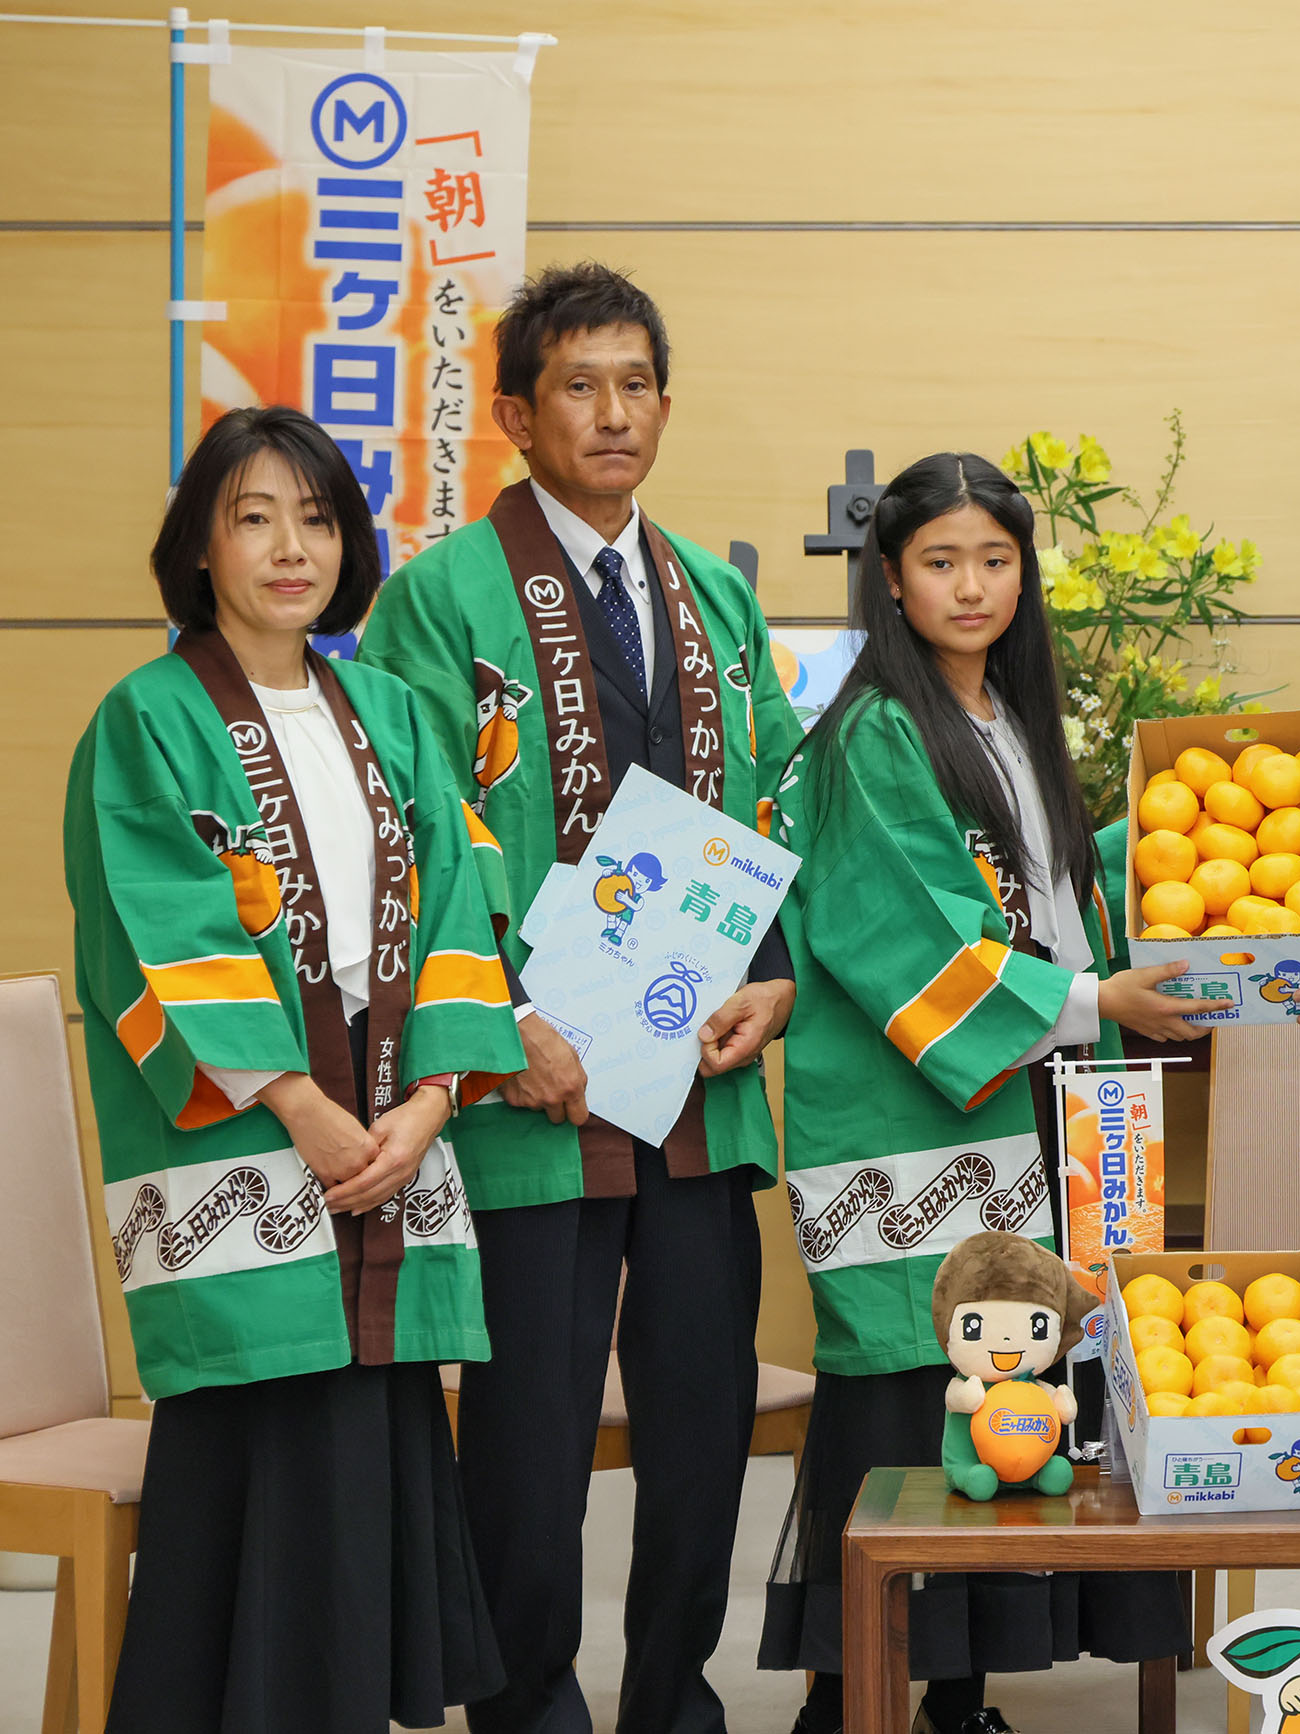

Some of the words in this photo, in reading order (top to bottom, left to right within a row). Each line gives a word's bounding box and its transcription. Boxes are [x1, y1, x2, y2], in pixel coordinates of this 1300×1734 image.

[415, 131, 496, 538] 「朝」をいただきま
[668, 561, 722, 804] JAみっかび
[351, 719, 408, 982] JAみっかび
[730, 856, 783, 890] mikkabi
[680, 879, 758, 946] 青島
[1181, 1008, 1240, 1022] mikkabi
[1126, 1093, 1151, 1213] 「朝」をいただきます。
[1172, 1462, 1233, 1487] 青島
[1184, 1490, 1235, 1502] mikkabi
